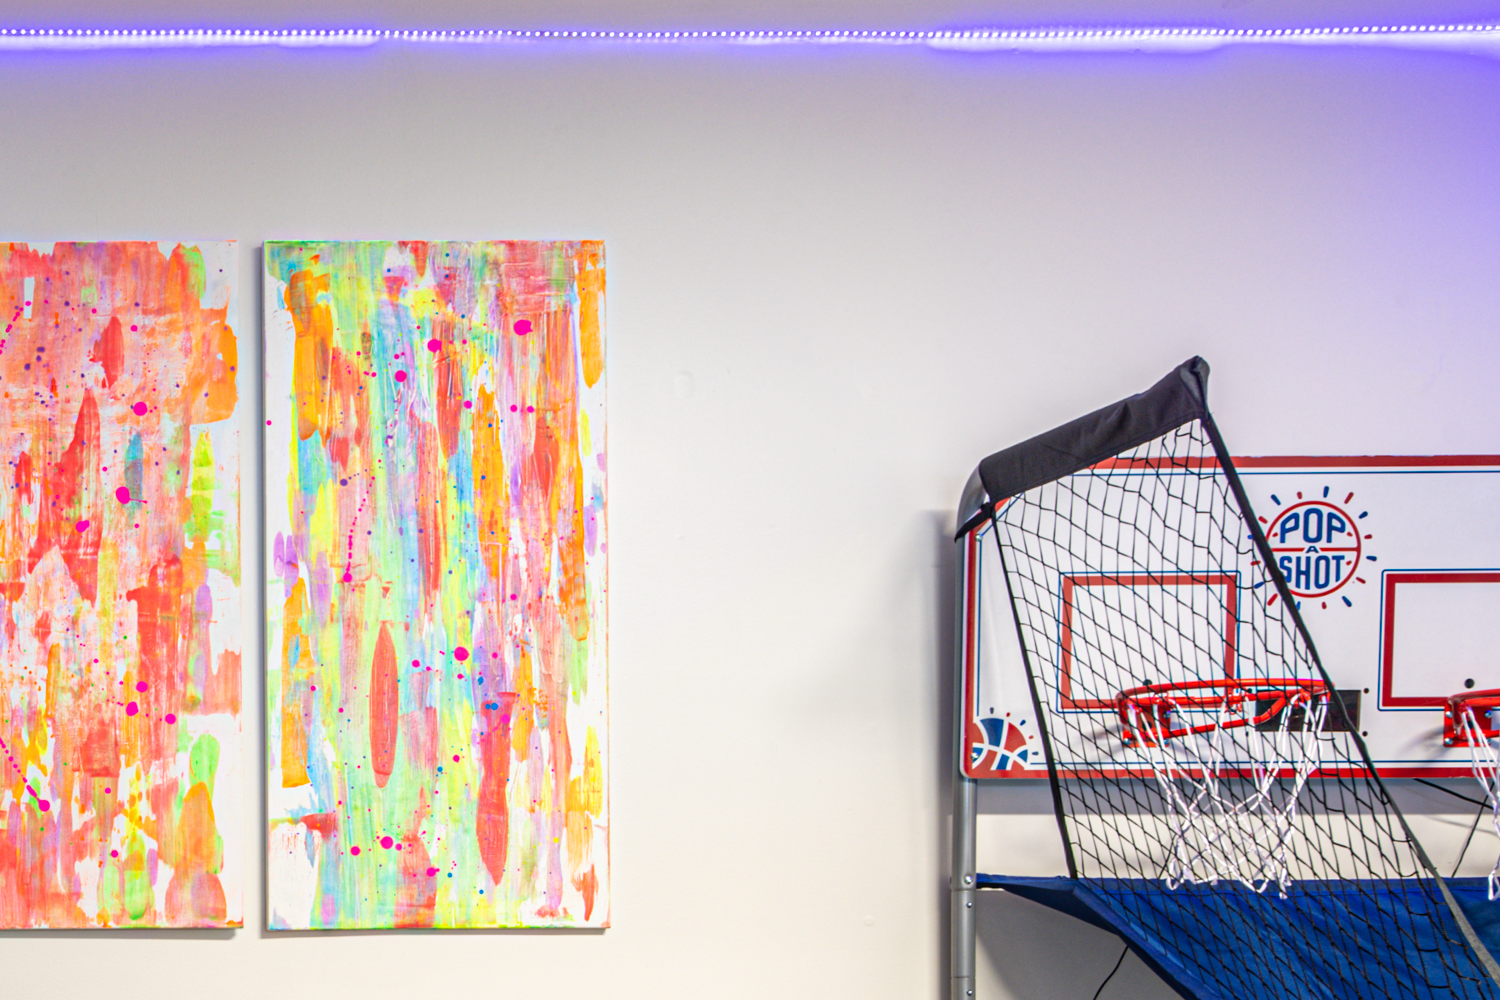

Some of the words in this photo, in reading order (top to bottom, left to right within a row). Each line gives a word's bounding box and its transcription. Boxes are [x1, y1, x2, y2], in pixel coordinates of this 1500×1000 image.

[1279, 507, 1346, 544] POP
[1305, 545, 1320, 554] A
[1279, 555, 1345, 590] SHOT
